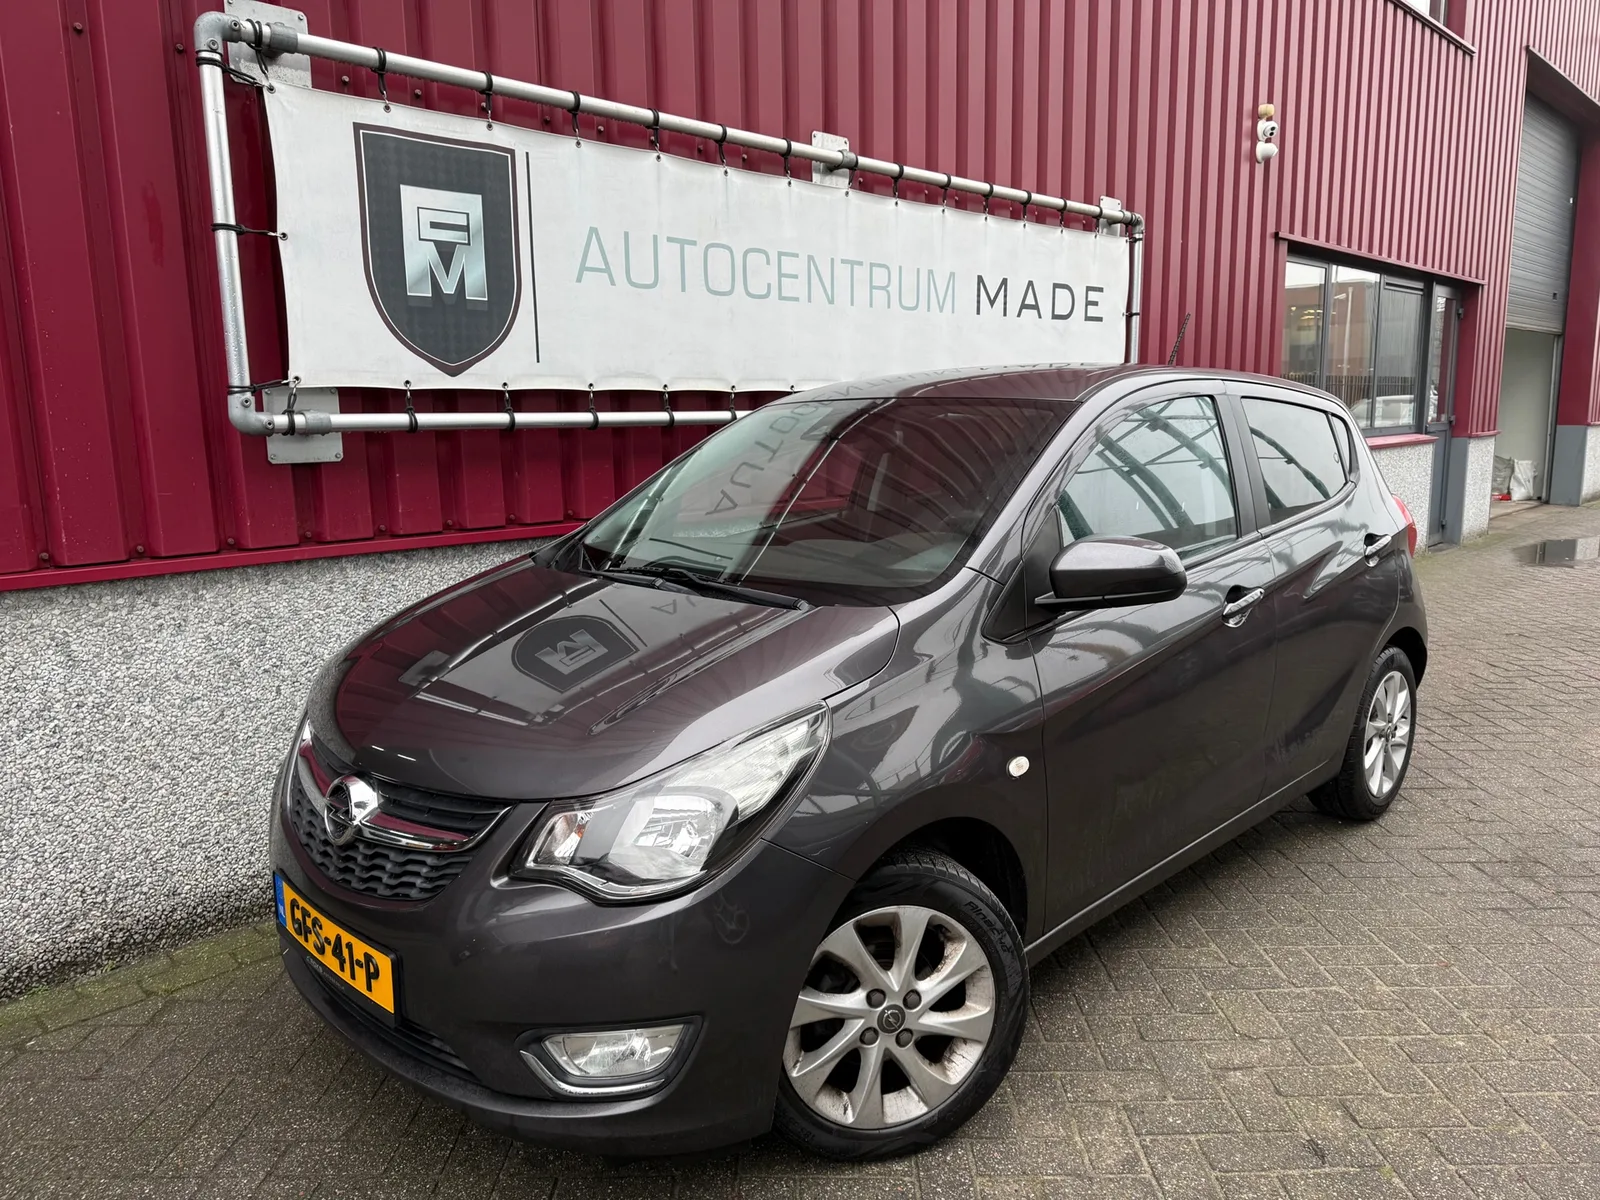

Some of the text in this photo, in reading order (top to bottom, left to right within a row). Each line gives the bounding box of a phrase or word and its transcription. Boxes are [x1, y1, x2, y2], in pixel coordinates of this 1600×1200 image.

[575, 226, 1104, 323] AUTOCENTRUM MADE
[290, 897, 380, 993] GFS-41-P
